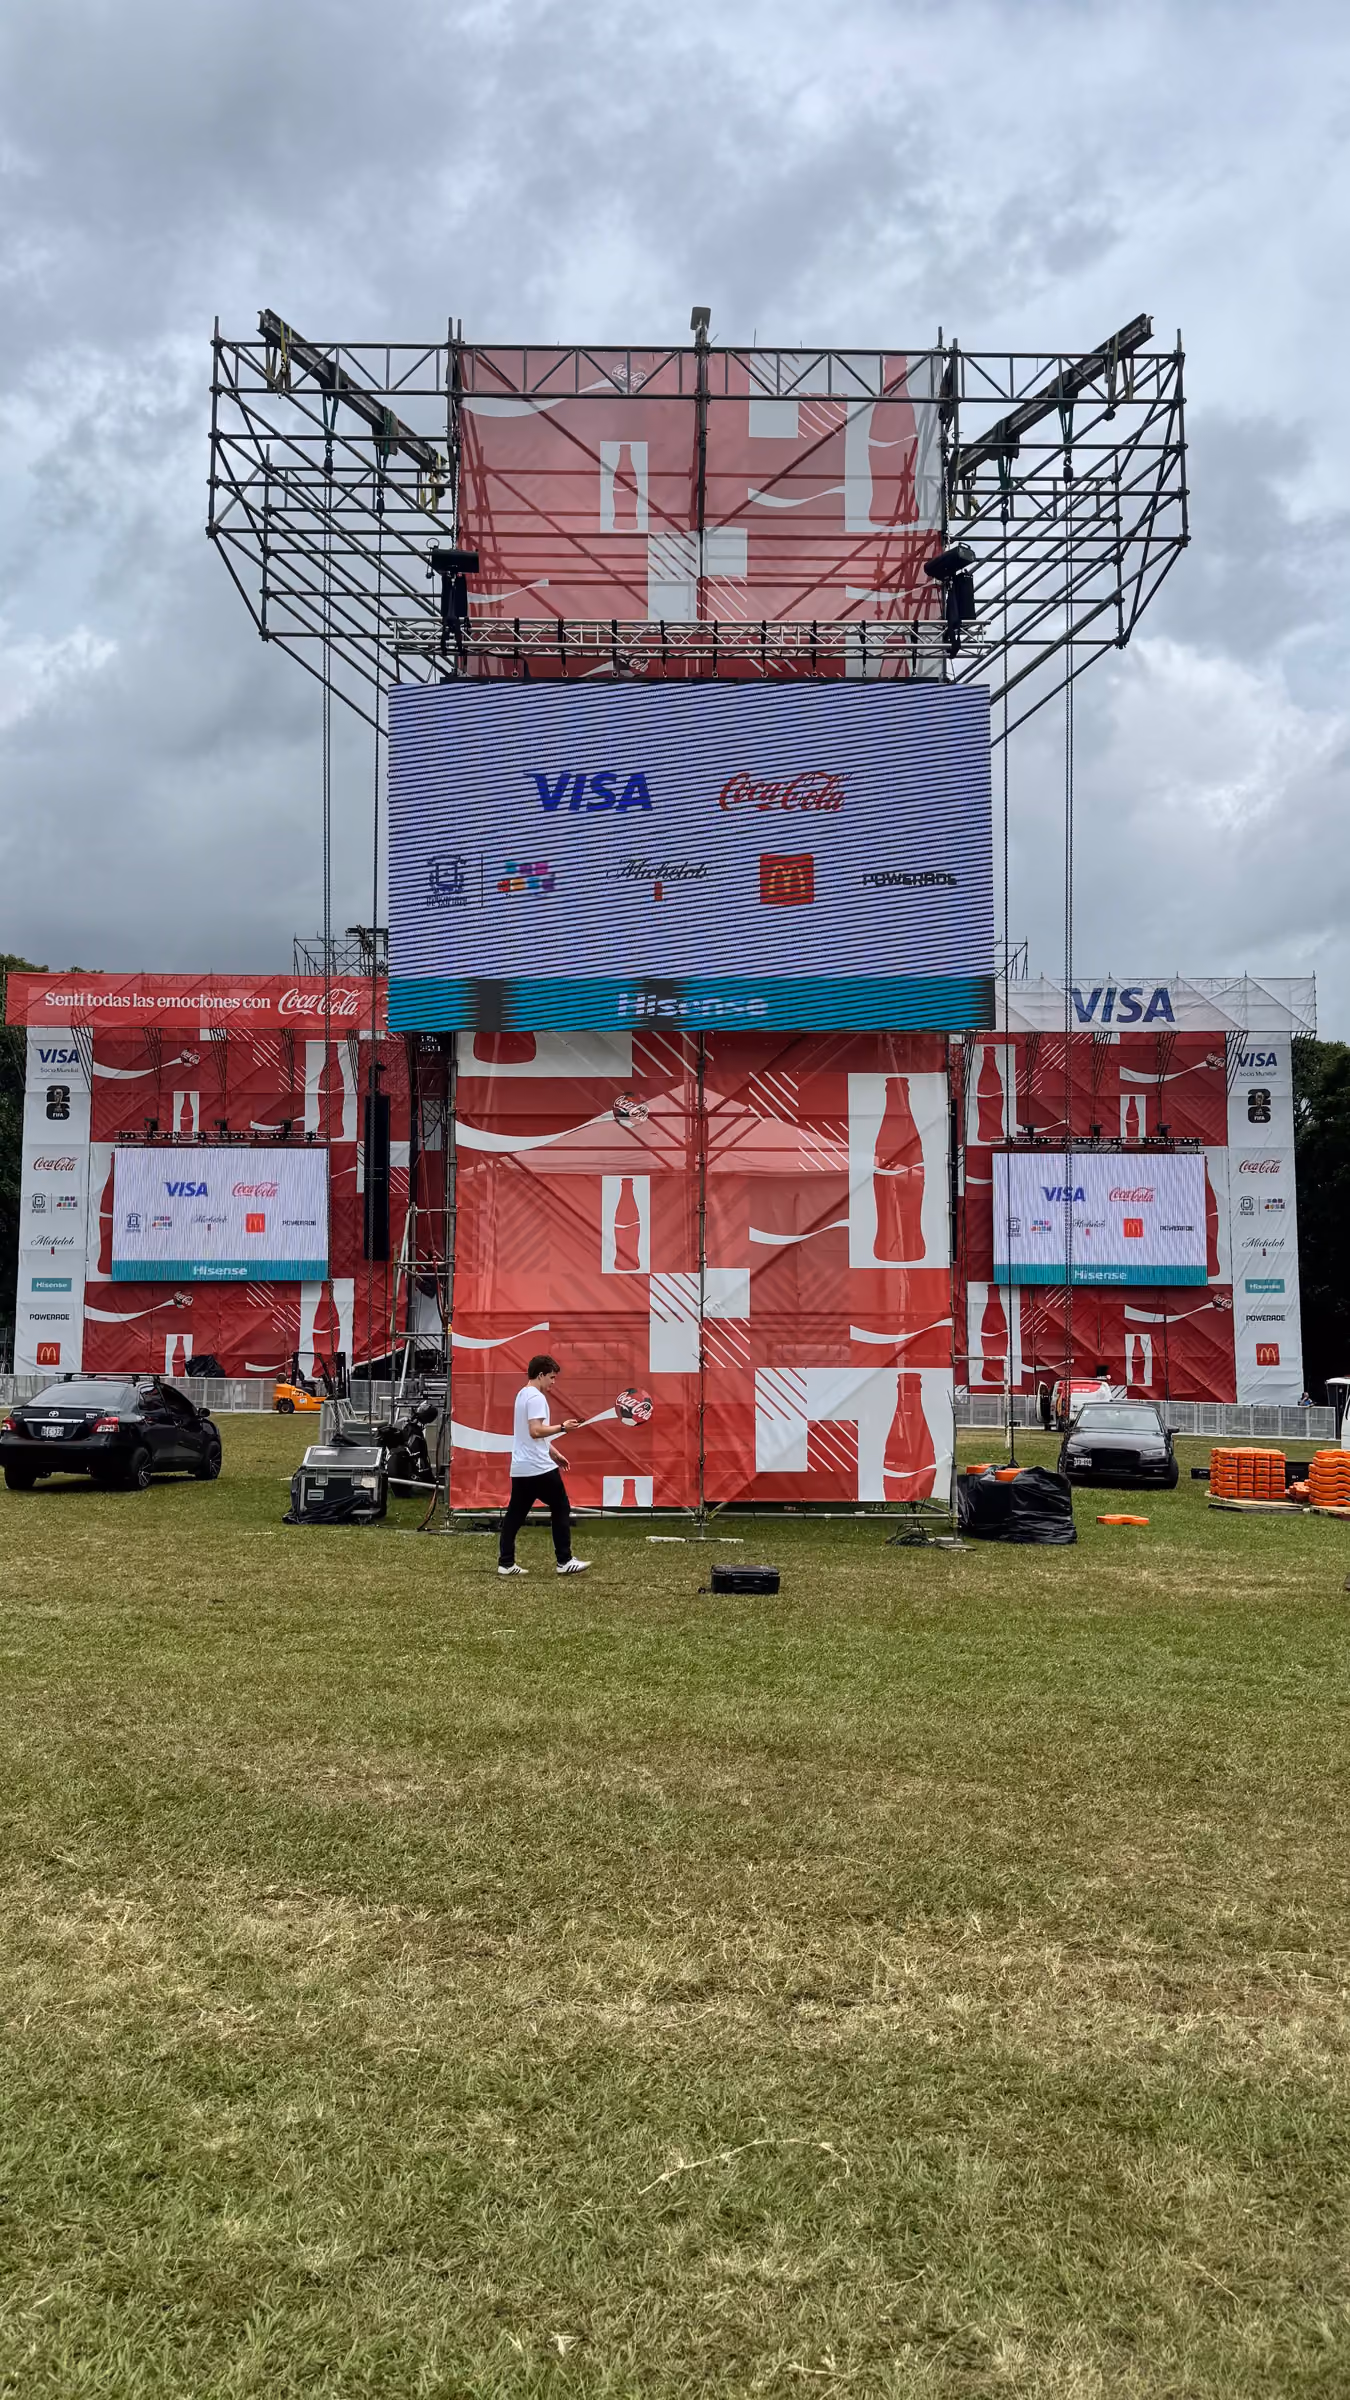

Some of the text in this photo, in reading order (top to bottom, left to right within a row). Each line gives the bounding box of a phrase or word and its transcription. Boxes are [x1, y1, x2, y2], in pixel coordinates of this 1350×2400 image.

[524, 773, 653, 811] VISA
[719, 772, 852, 811] Coca-Cola
[87, 993, 131, 1008] todas
[133, 993, 154, 1008] las
[157, 994, 240, 1009] emociones
[243, 997, 270, 1009] con
[278, 988, 361, 1016] Coca-Cola
[1061, 987, 1175, 1023] VISA
[36, 1048, 80, 1063] VISA
[1236, 1052, 1278, 1067] VISA
[33, 1156, 78, 1171] Coca-Cola
[1239, 1159, 1282, 1173] Coca-Cola
[164, 1182, 208, 1197] VISA
[232, 1182, 279, 1197] Coca-Cola
[1041, 1186, 1085, 1202] VISA
[31, 1235, 74, 1246] Michelob
[1242, 1237, 1285, 1249] Michelob
[193, 1265, 248, 1276] Hisense
[1074, 1270, 1128, 1280] Hisense
